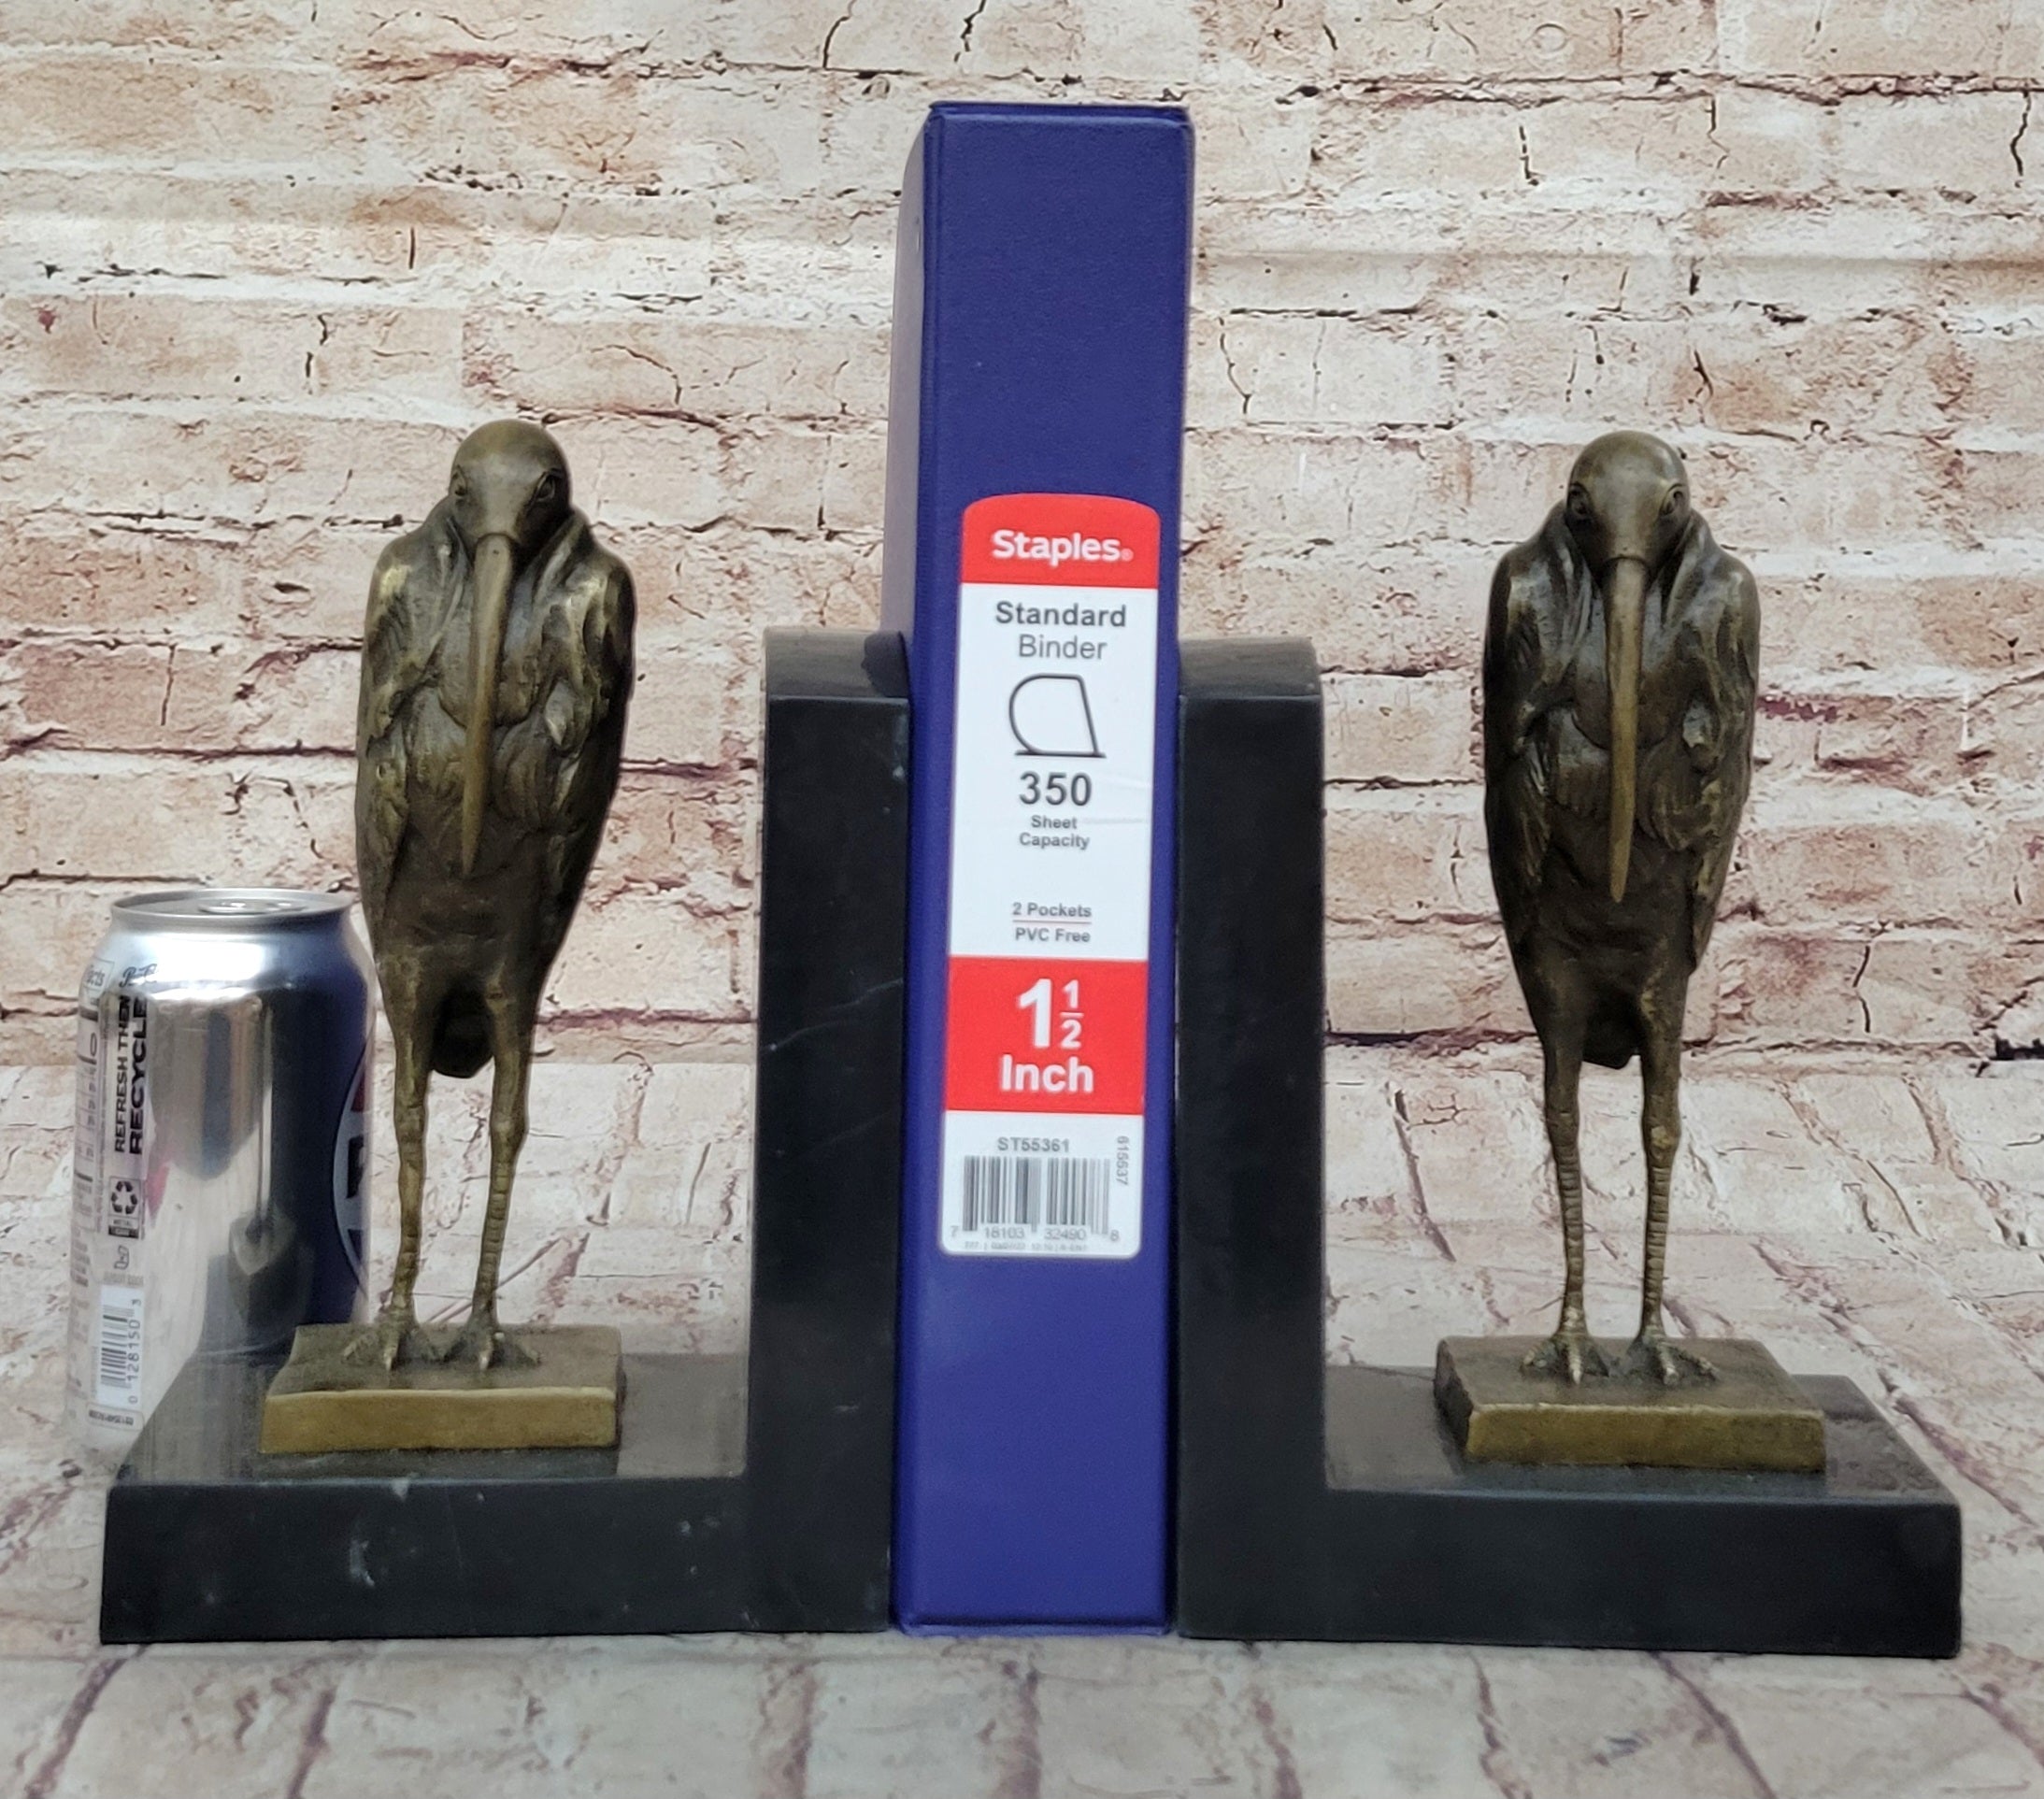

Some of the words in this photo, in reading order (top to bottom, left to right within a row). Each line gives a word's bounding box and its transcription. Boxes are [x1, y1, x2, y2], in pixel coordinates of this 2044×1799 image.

[992, 530, 1121, 567] Staples
[995, 601, 1126, 627] Standard
[1019, 635, 1107, 659] Binder
[1019, 771, 1092, 806] 350
[1031, 815, 1077, 829] Sheet
[1019, 833, 1090, 850] Capacity
[1012, 902, 1022, 917] 2
[1027, 902, 1092, 919] Pockets
[1015, 928, 1050, 942] PVC
[1054, 929, 1091, 943] Free
[118, 994, 131, 1050] THEN
[130, 995, 147, 1154] RECYCLE
[1000, 1054, 1093, 1092] Inch
[115, 1055, 128, 1152] REFRESH
[997, 1136, 1070, 1153] ST55361
